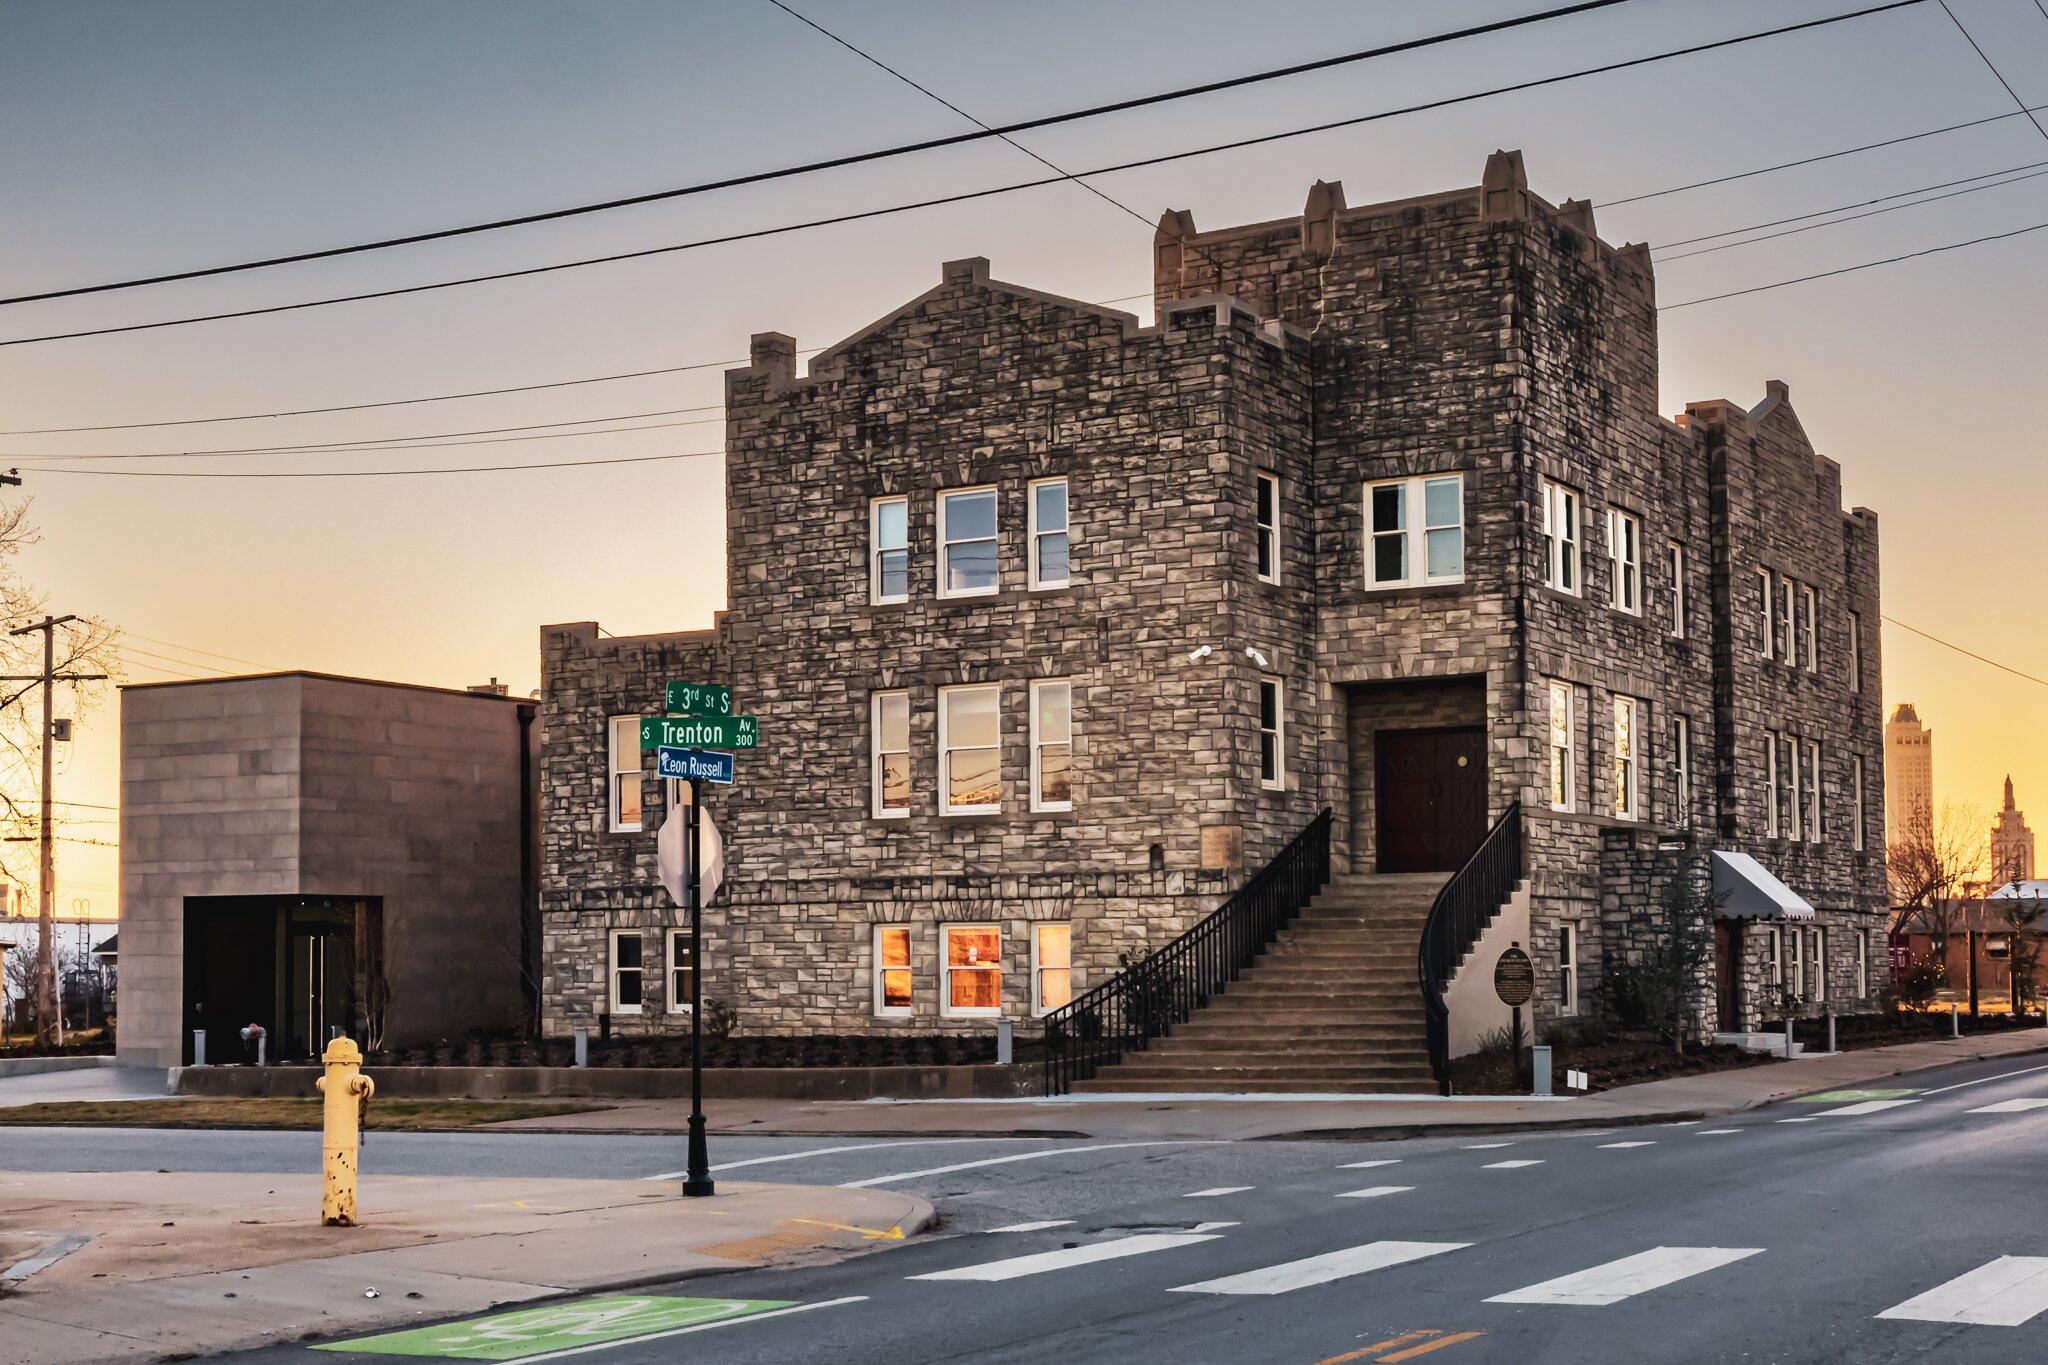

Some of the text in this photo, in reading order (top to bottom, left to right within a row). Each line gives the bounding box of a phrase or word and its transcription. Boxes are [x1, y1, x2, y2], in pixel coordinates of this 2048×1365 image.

[668, 690, 673, 703] E
[682, 687, 700, 710] 3rd
[705, 694, 714, 708] St
[643, 726, 650, 740] S
[661, 722, 723, 744] Trenton
[735, 734, 753, 746] 300
[664, 757, 723, 778] Leon Russell
